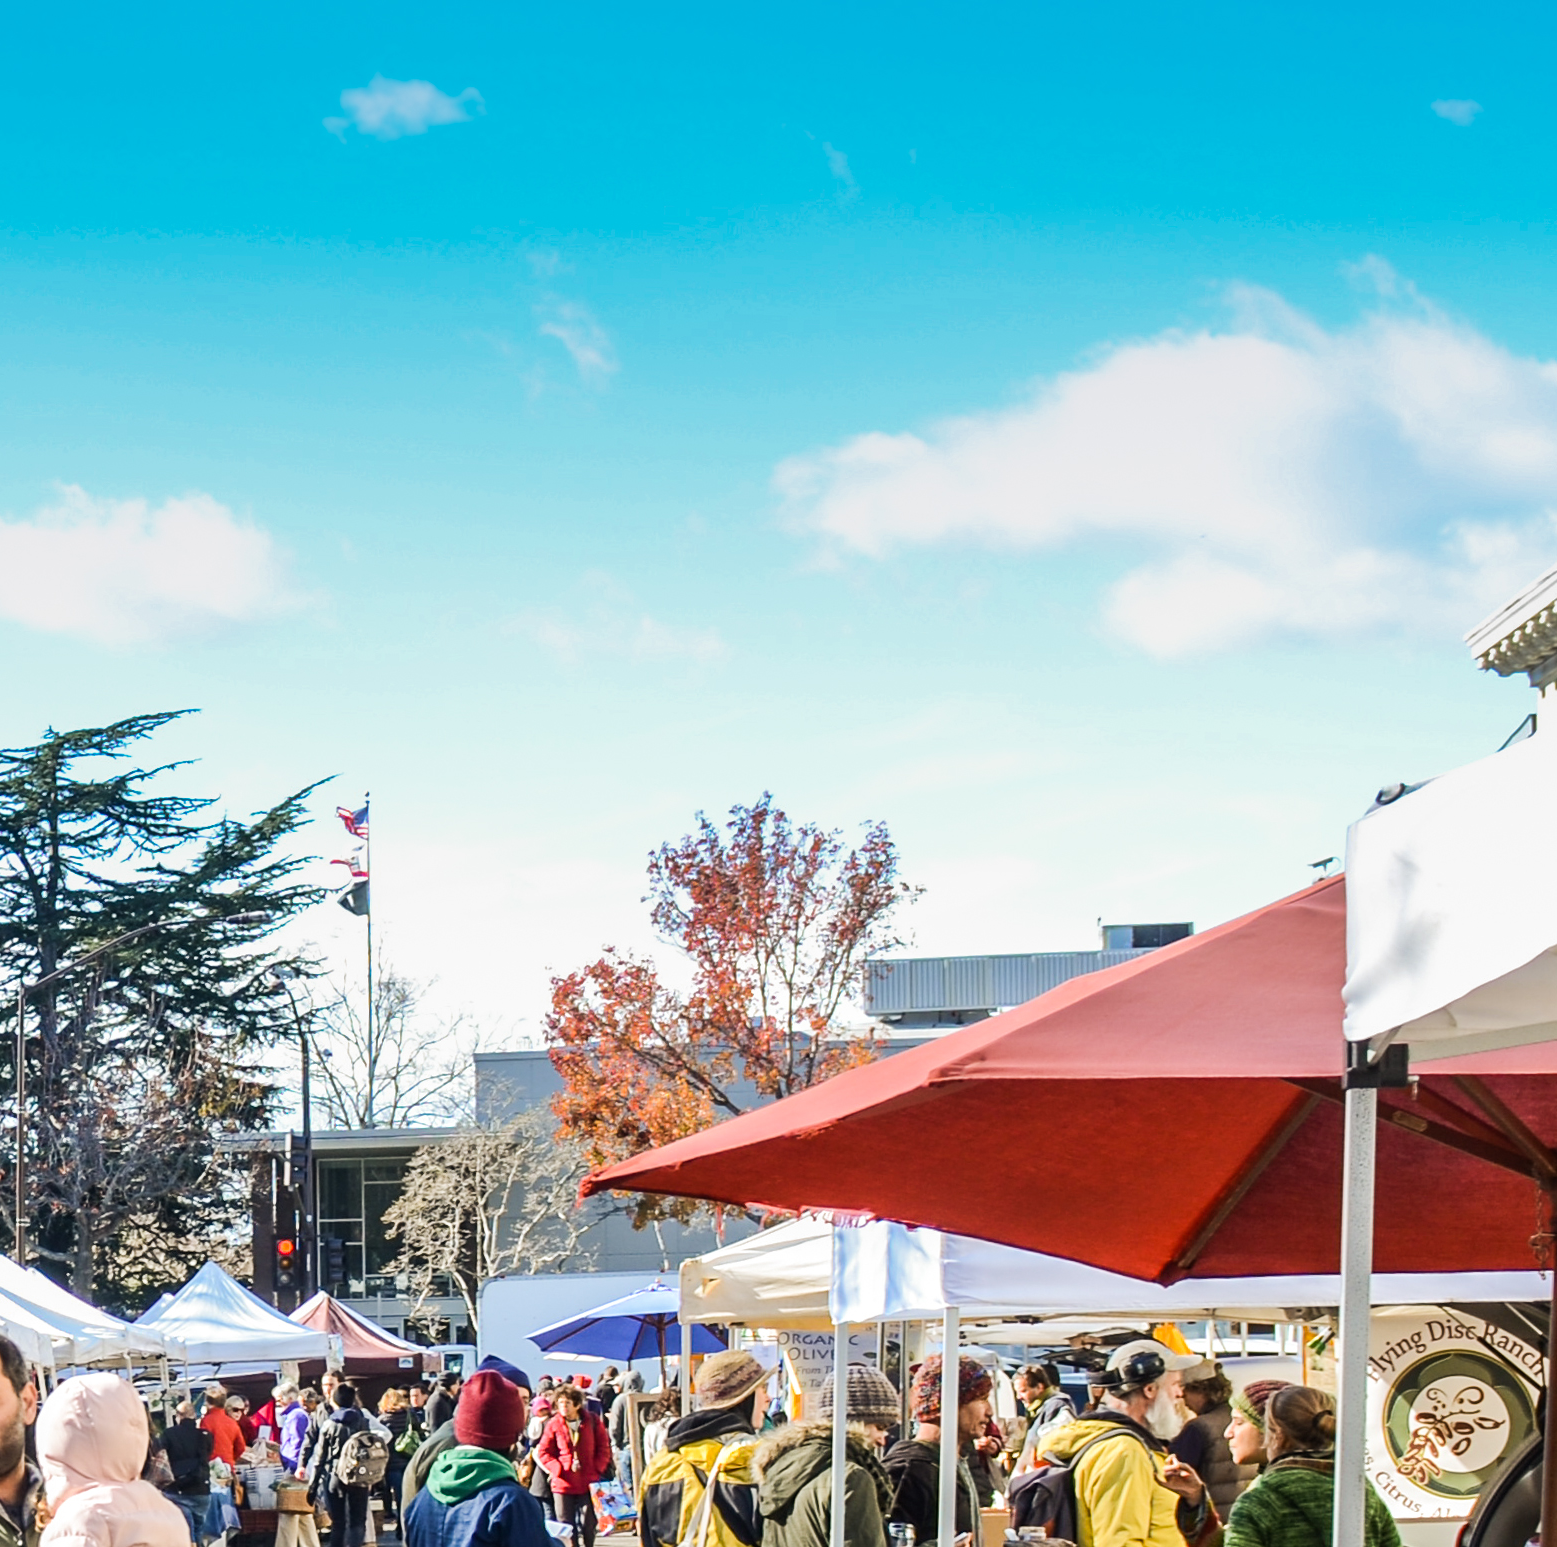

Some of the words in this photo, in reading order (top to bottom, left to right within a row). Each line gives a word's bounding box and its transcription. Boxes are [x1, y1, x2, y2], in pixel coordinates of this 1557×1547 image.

[777, 1331, 859, 1346] ORGANC
[1425, 1319, 1478, 1342] Disc
[1483, 1321, 1545, 1377] Ranch
